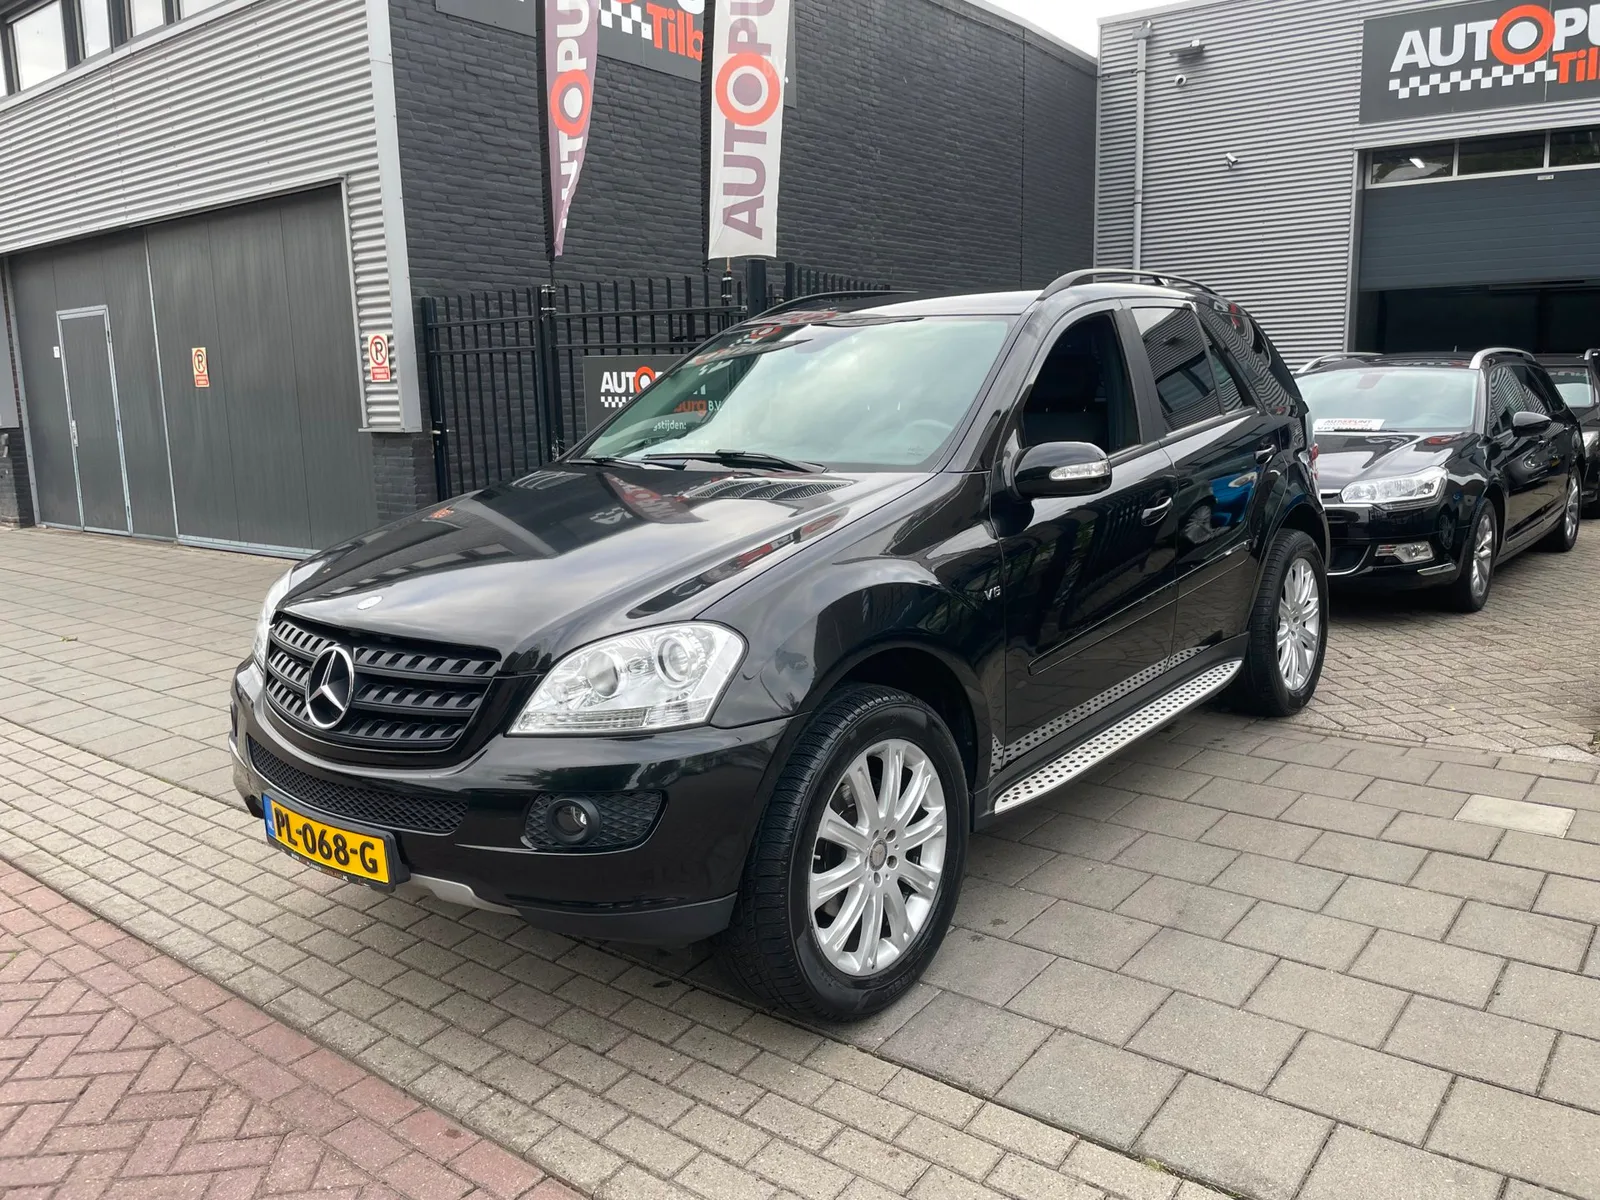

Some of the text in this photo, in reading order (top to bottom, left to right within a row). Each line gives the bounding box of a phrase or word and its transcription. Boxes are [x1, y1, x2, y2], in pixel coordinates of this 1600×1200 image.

[1552, 46, 1600, 84] Til
[984, 585, 1001, 601] V6
[274, 807, 379, 874] PL-068-G
